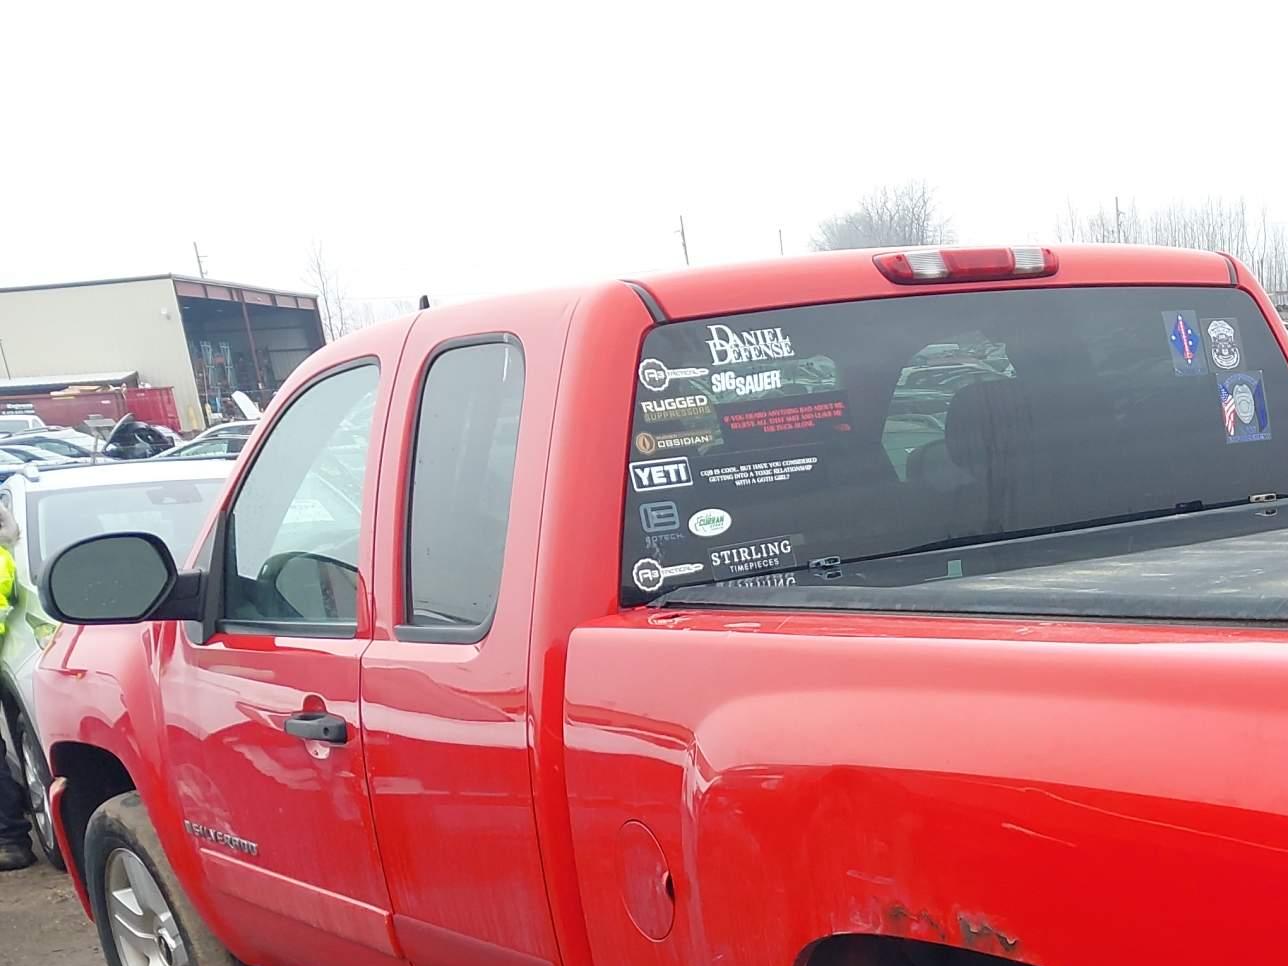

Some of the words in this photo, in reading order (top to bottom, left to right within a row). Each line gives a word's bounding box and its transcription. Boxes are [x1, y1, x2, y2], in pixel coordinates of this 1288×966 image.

[706, 325, 790, 350] DANIEL
[704, 339, 795, 366] DEFENSE
[711, 371, 736, 393] SIG
[735, 370, 781, 396] SAUER
[640, 395, 708, 413] RUGGED
[657, 435, 709, 448] OBSIDIAN
[634, 463, 690, 486] YETI
[710, 540, 792, 566] STIRLING
[729, 557, 780, 573] TIMEPIECES
